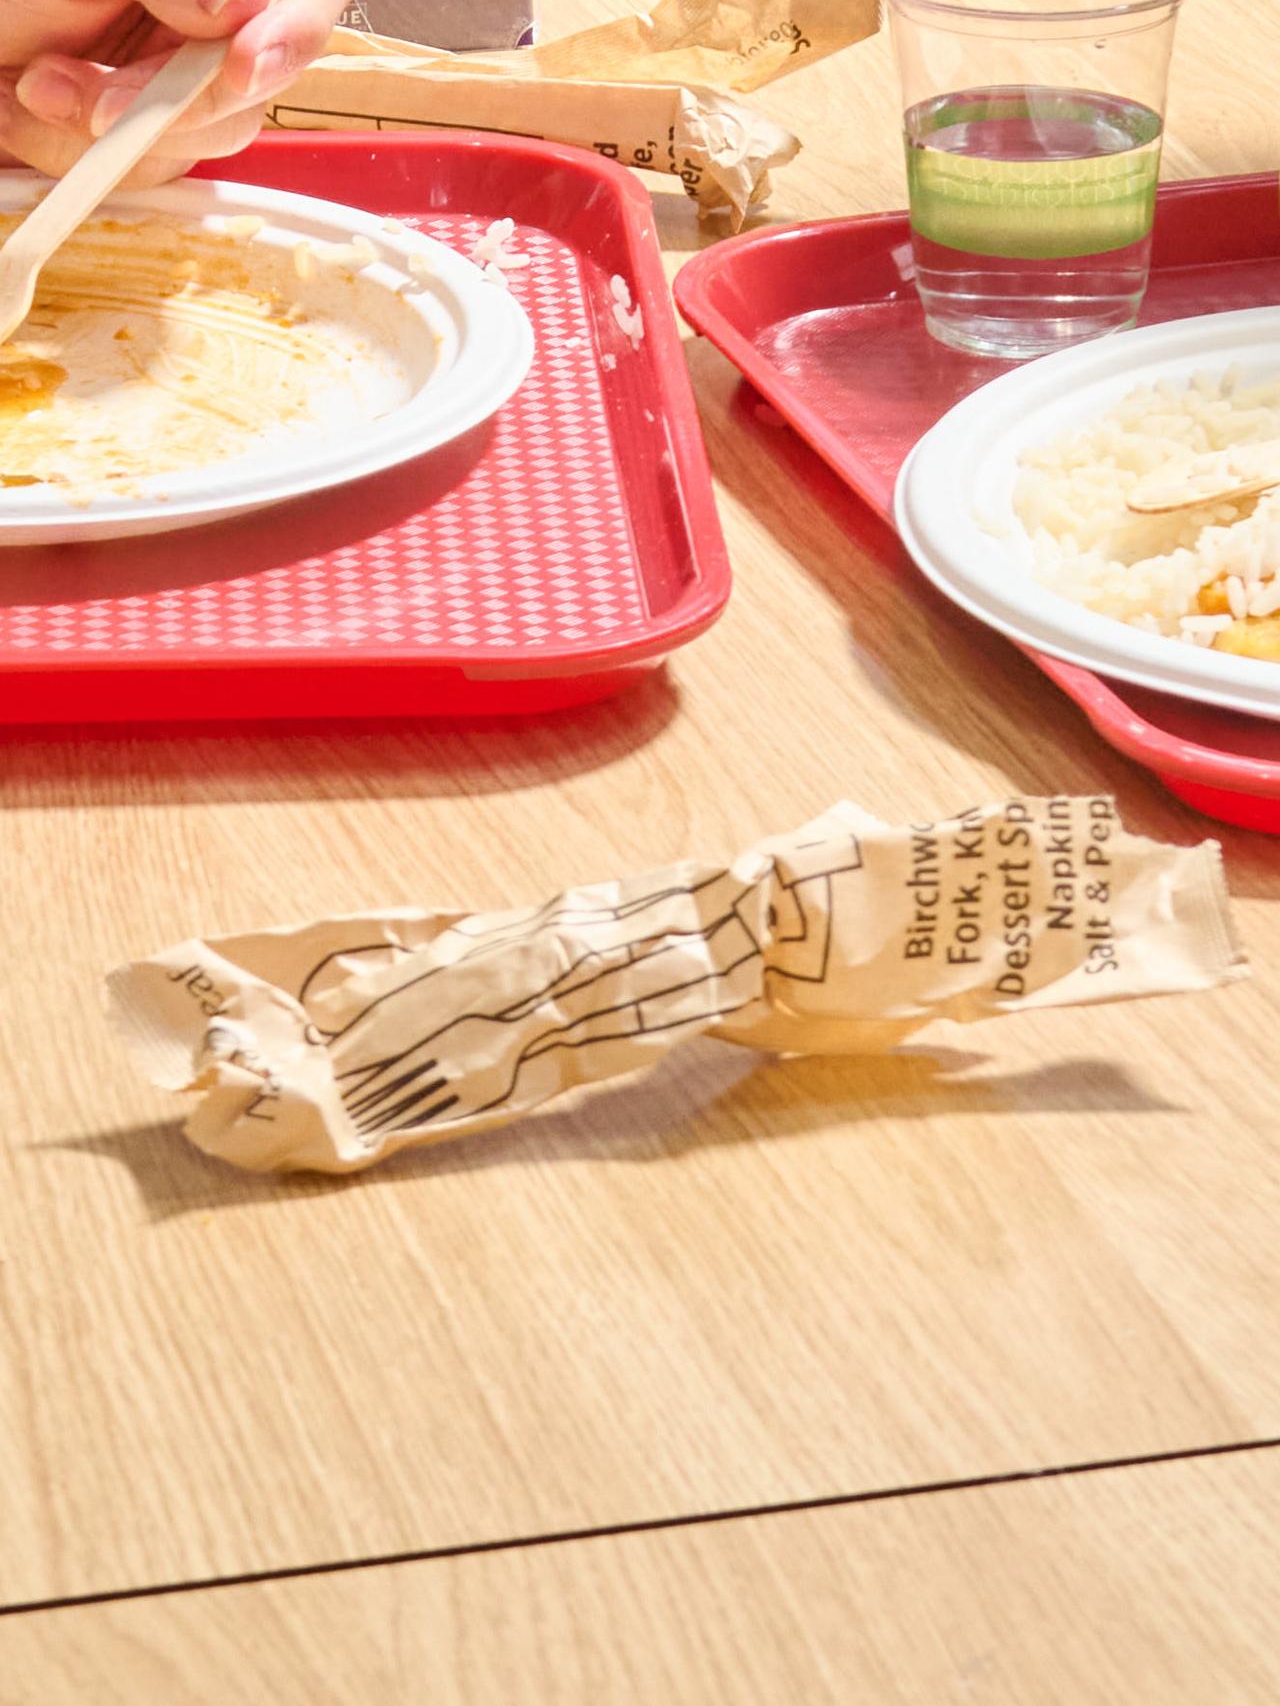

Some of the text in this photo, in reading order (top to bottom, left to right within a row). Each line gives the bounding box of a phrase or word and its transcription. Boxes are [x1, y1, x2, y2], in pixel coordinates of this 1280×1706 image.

[946, 871, 990, 966] Fork,
[994, 859, 1032, 996] Dessert
[1045, 800, 1078, 930] Napkin
[1084, 798, 1119, 975] Salt & Pep
